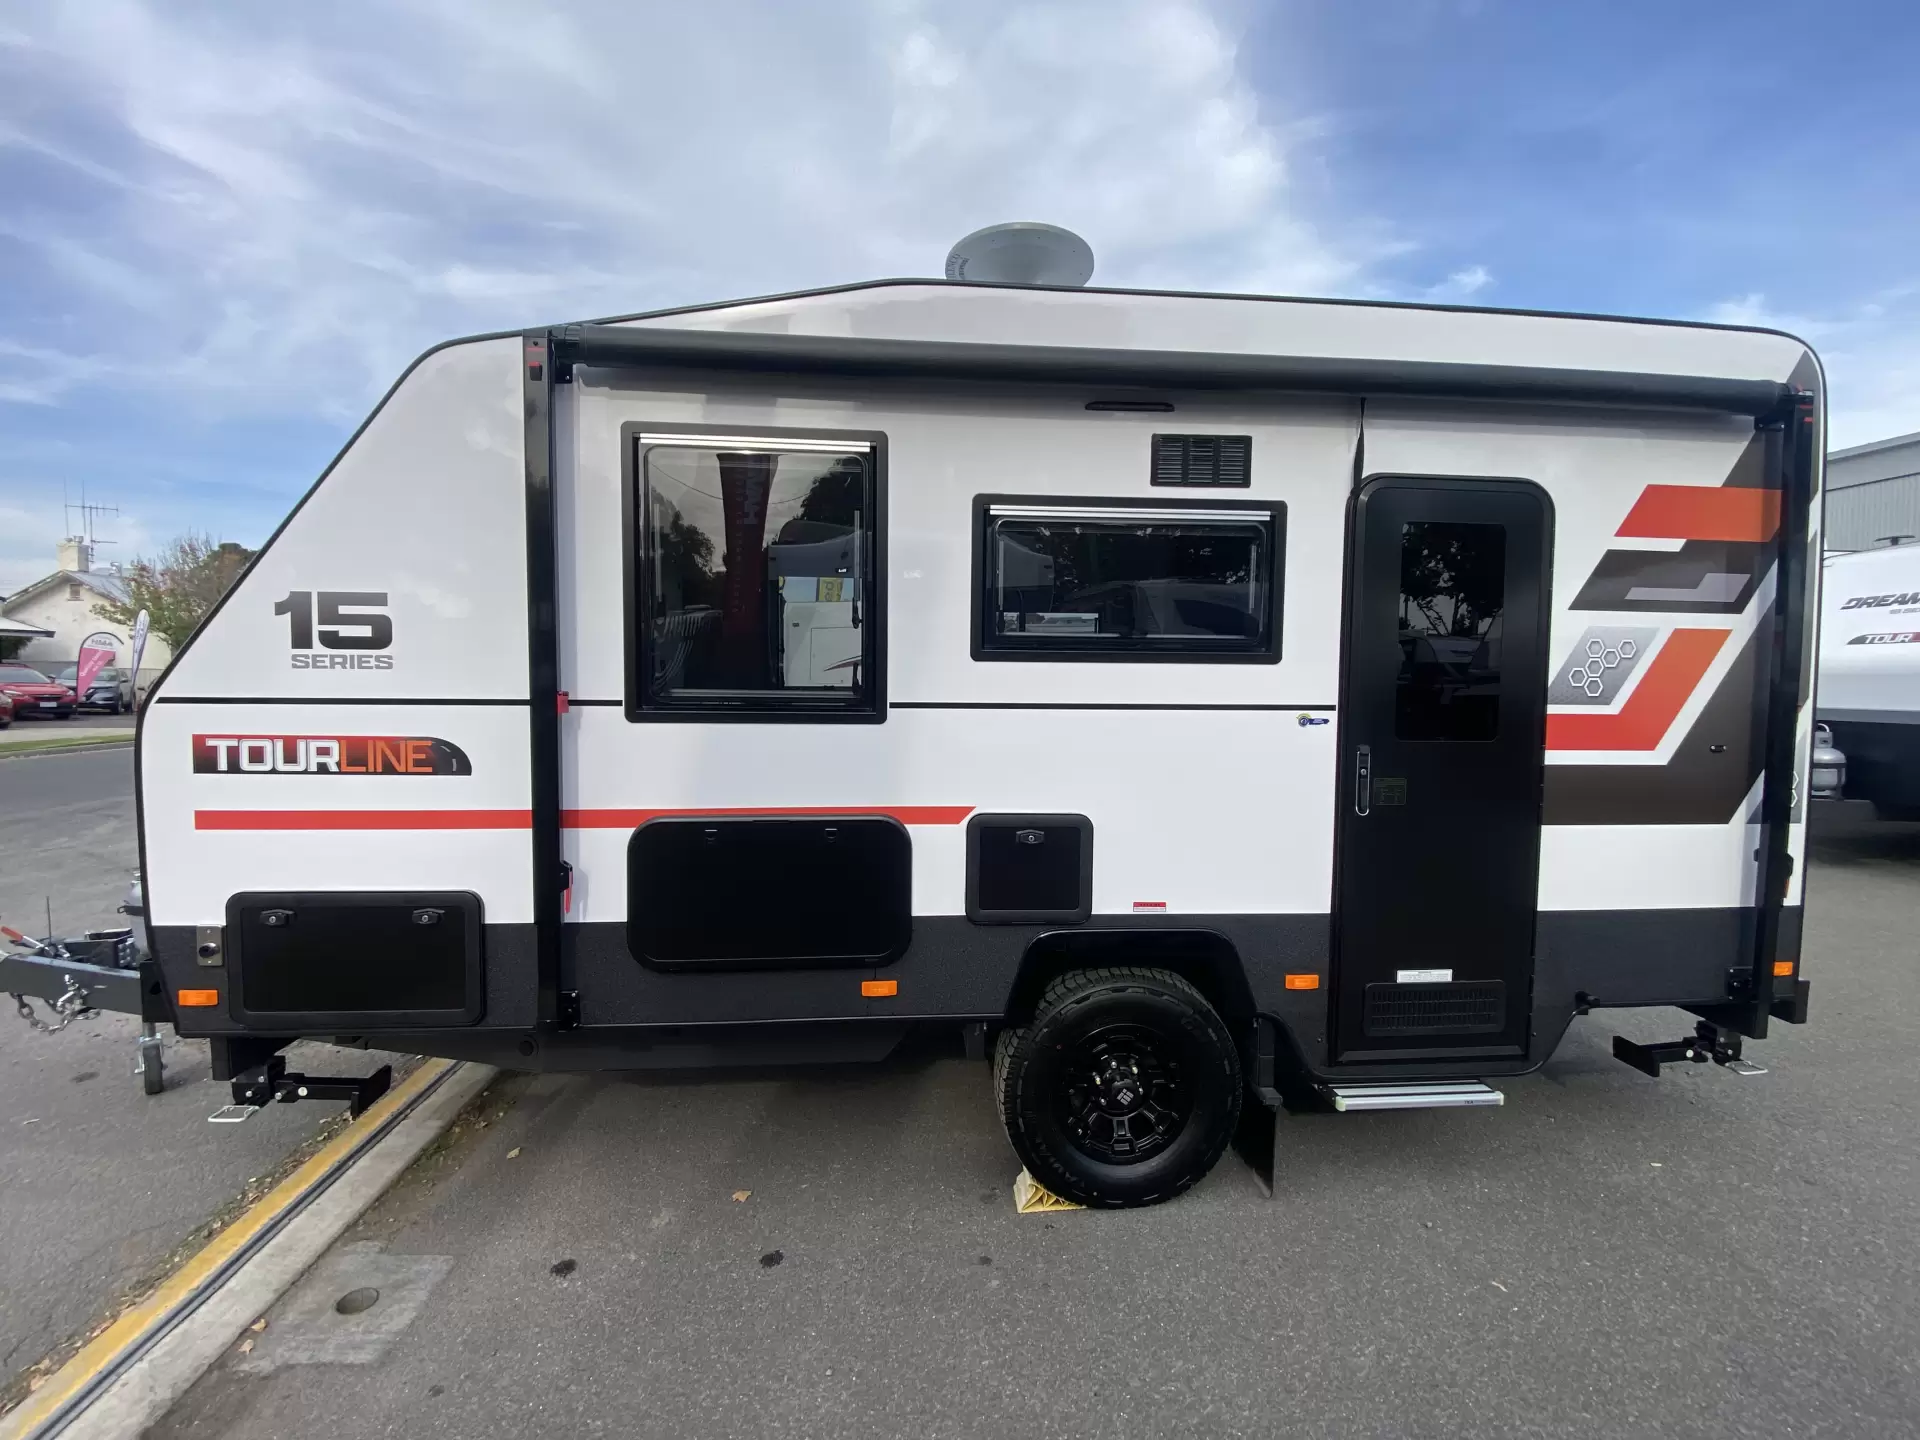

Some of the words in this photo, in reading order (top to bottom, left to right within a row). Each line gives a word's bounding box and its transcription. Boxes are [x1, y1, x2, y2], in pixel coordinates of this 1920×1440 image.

[274, 590, 393, 650] 15
[1865, 633, 1912, 643] TOUR
[291, 654, 394, 670] SERIES
[205, 737, 433, 772] TOURLINE
